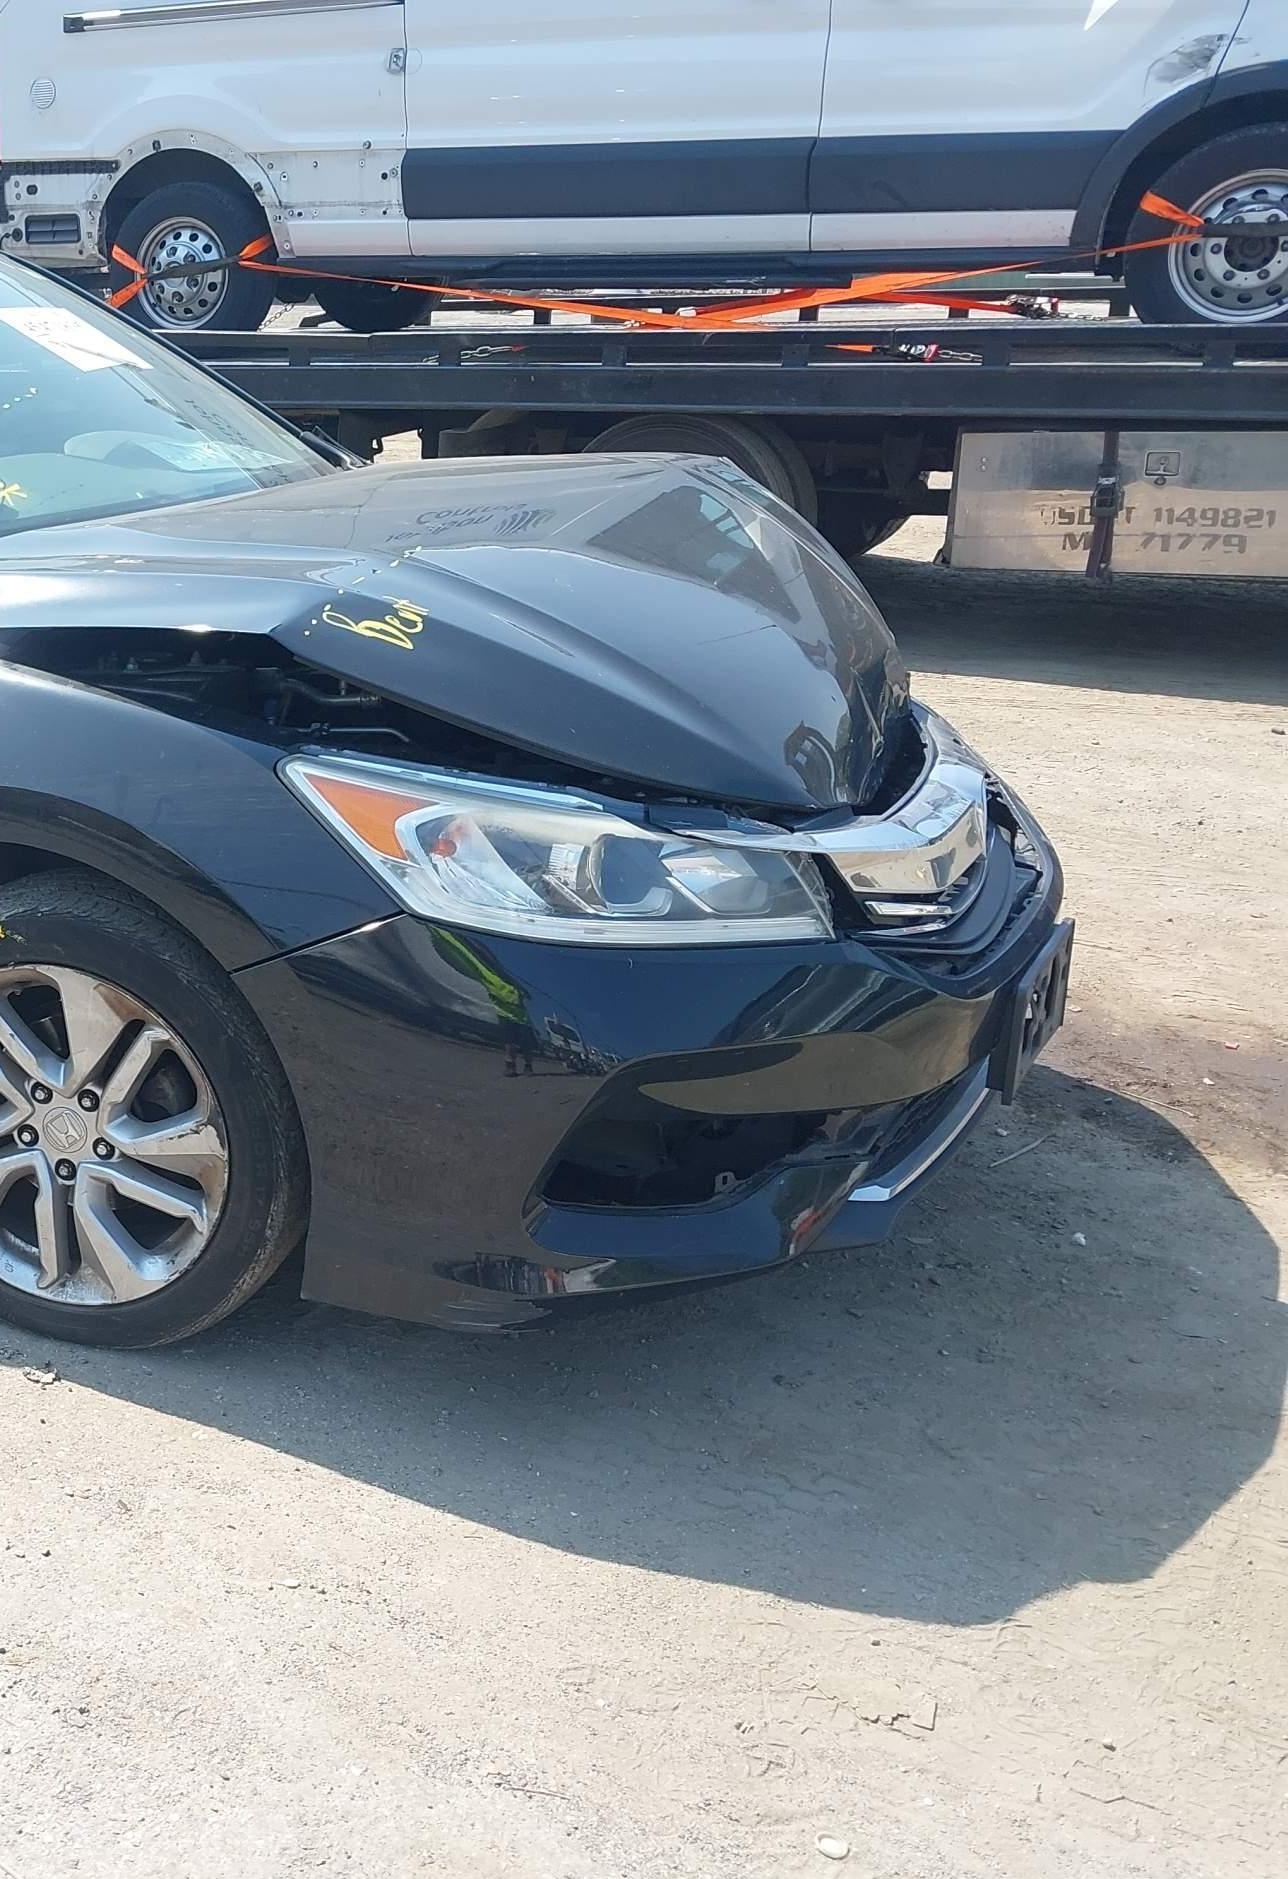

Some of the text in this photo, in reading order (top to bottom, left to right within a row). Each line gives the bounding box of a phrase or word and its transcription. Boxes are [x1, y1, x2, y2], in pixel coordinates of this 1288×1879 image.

[1040, 506, 1277, 529] USDT 1149821
[1139, 531, 1248, 555] 71779
